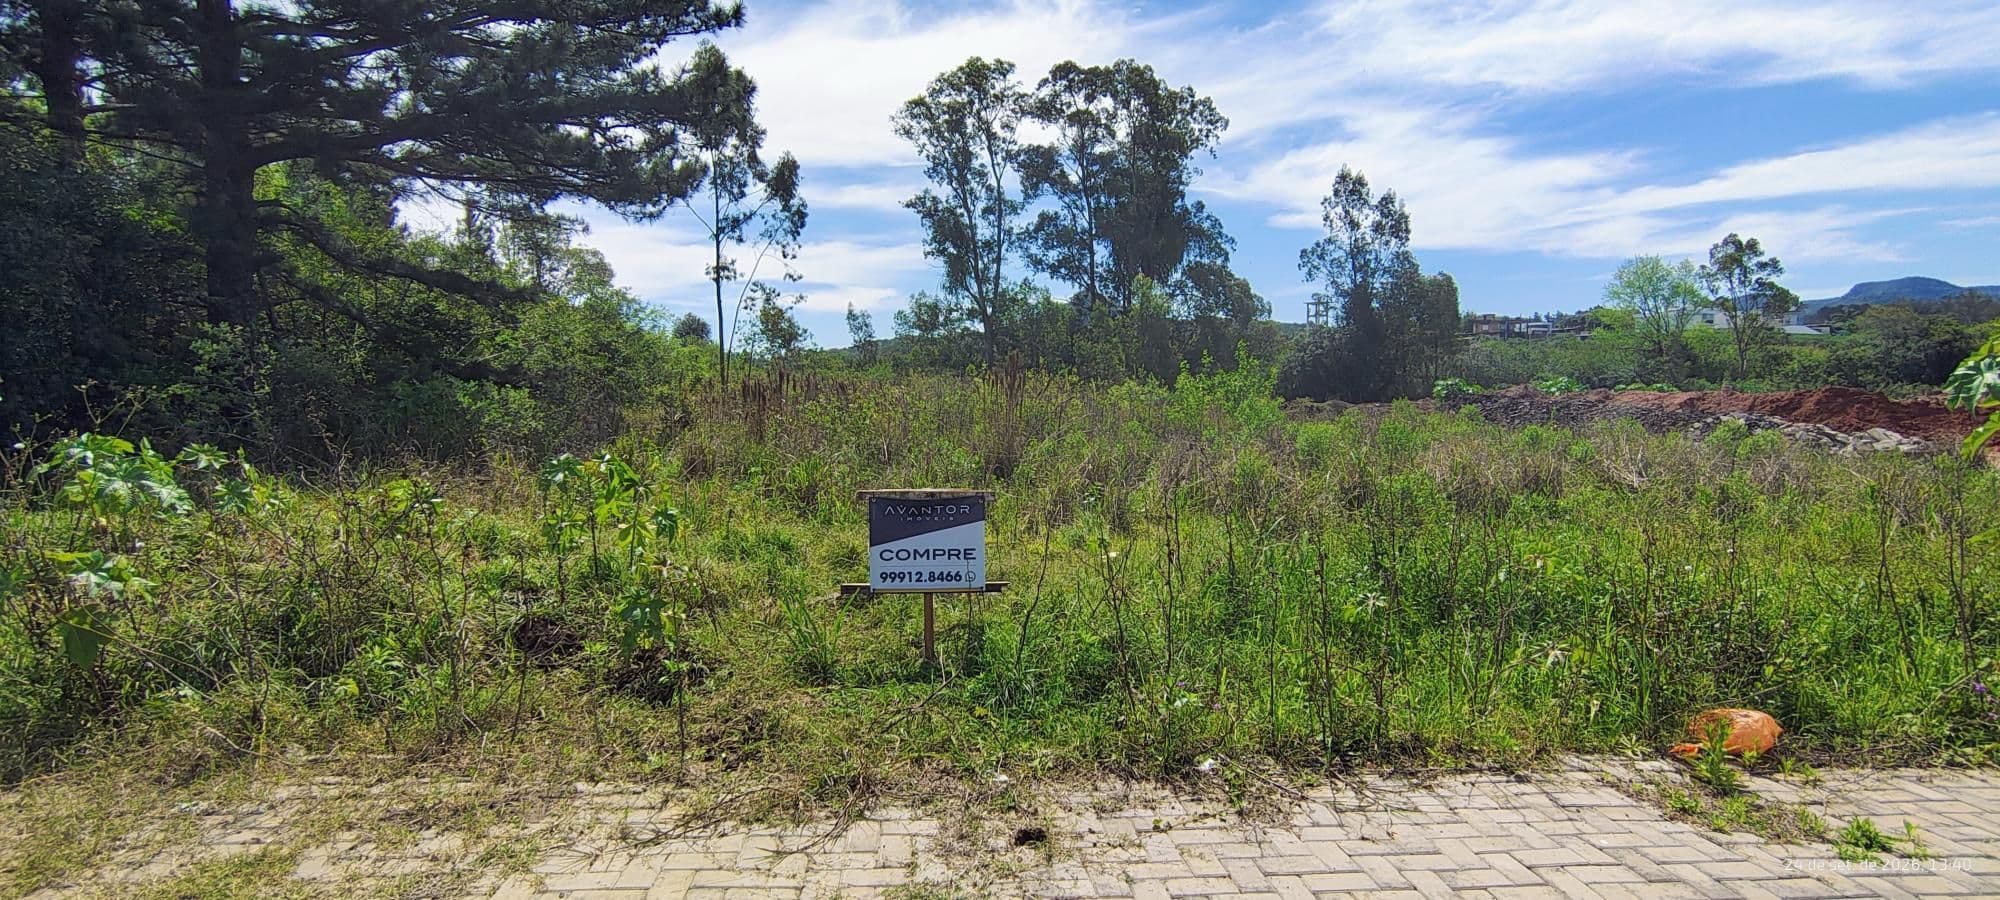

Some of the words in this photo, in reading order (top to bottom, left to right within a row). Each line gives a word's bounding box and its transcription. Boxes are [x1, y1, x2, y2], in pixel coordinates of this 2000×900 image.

[884, 505, 970, 515] AVANTOR
[879, 548, 976, 561] COMPRE
[880, 571, 962, 583] 99912.8466
